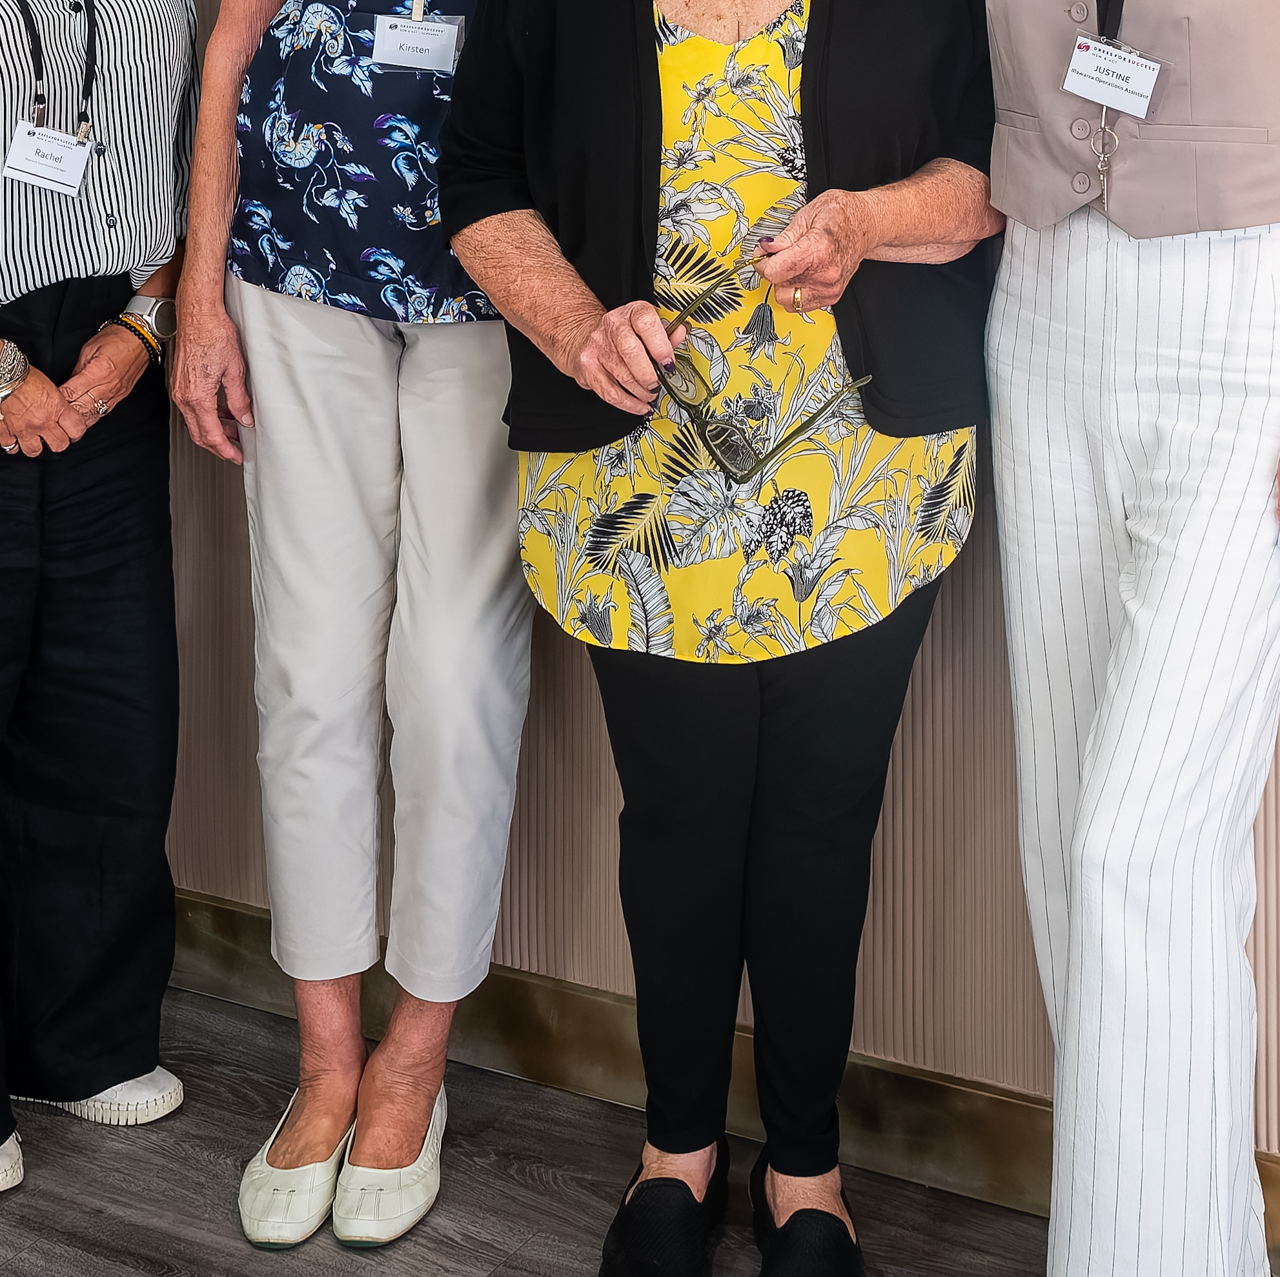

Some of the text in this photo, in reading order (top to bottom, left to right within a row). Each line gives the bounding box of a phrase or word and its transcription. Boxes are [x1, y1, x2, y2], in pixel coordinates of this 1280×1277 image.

[399, 42, 430, 55] Kirsten
[1093, 65, 1131, 84] JUSTINE
[1095, 76, 1124, 91] Operations
[1124, 87, 1149, 100] Assistant
[34, 147, 63, 164] Rachel
